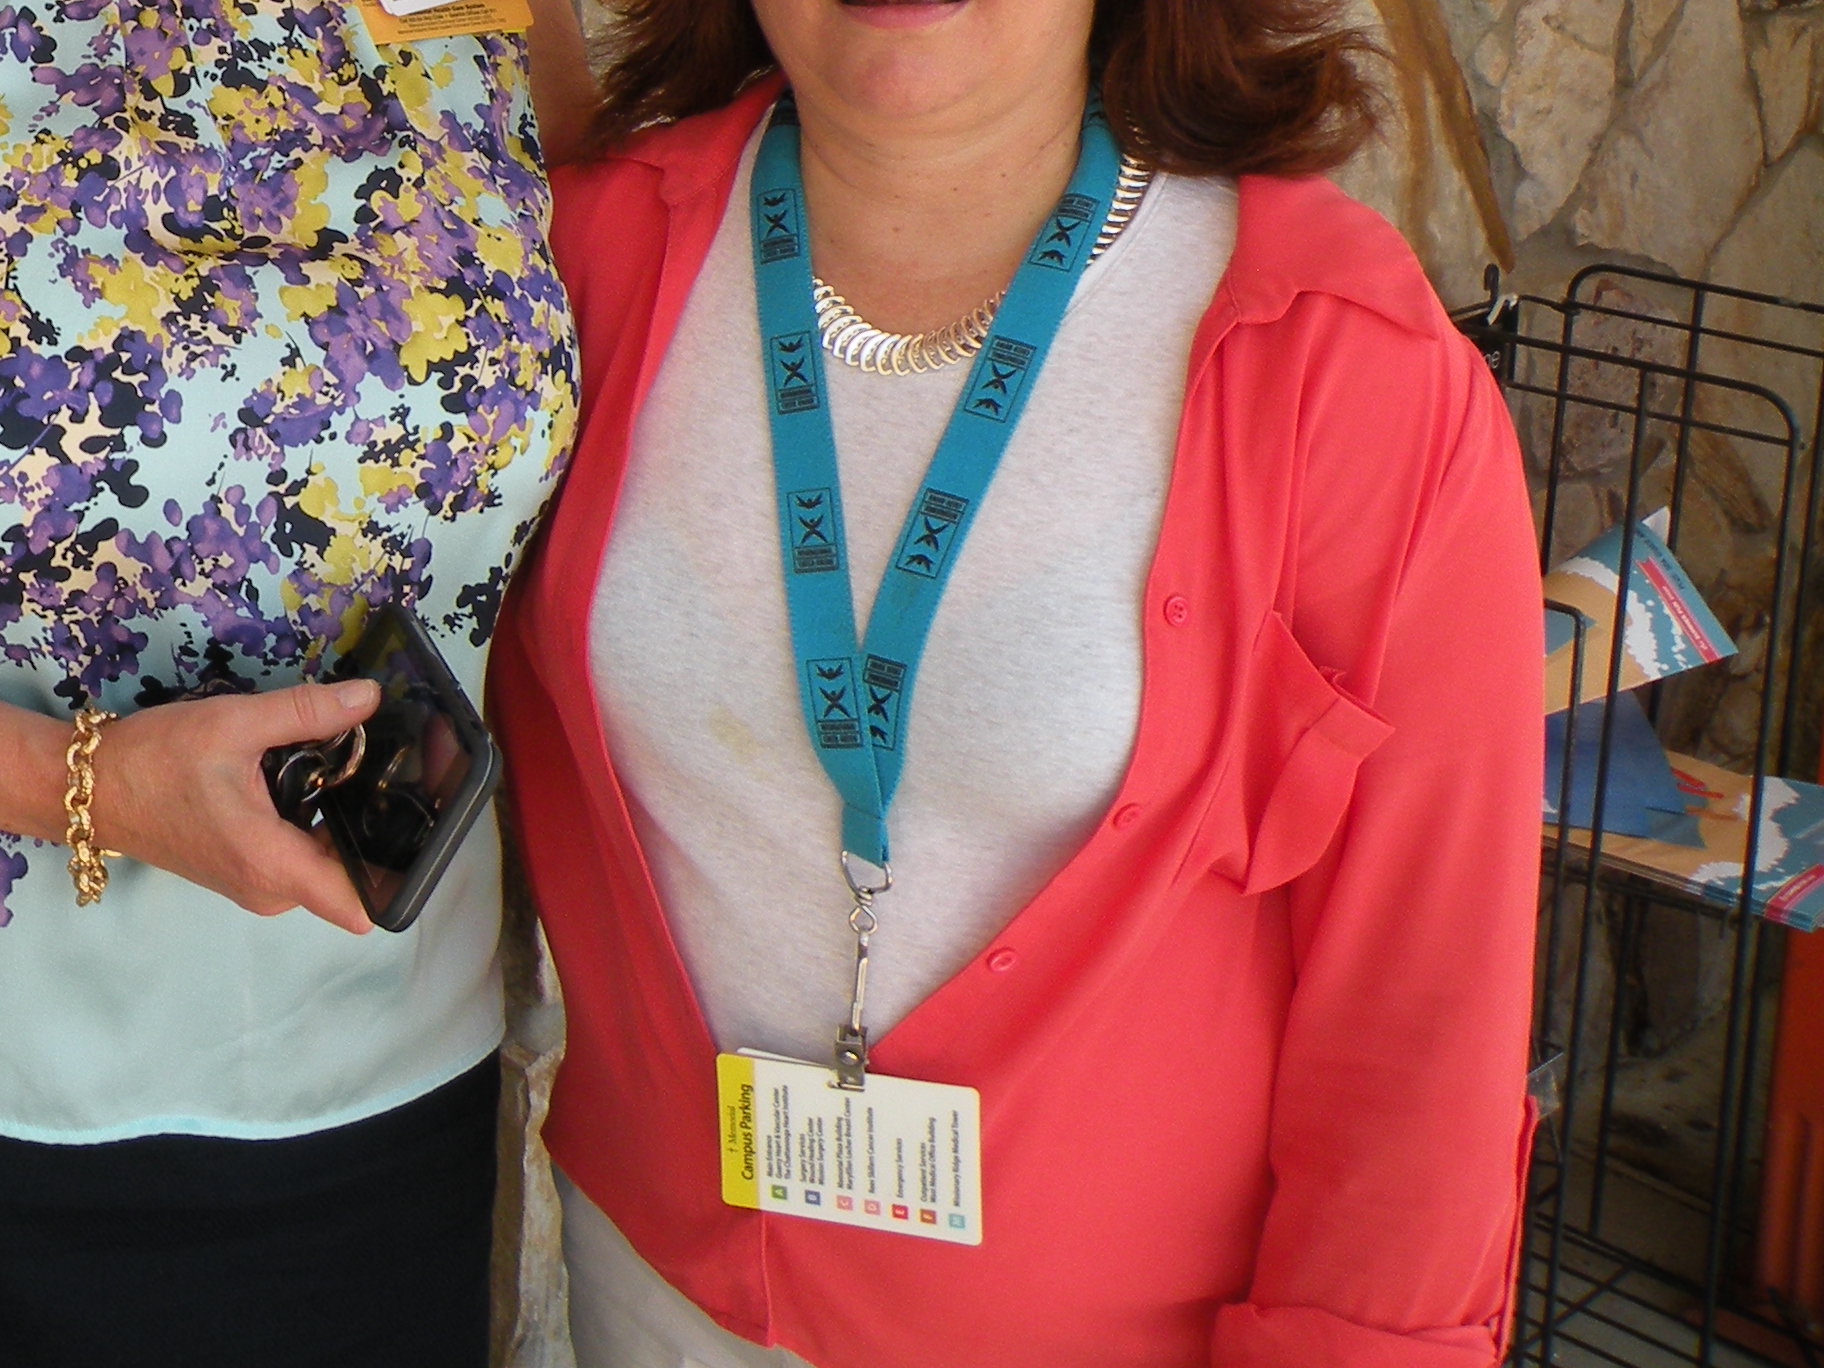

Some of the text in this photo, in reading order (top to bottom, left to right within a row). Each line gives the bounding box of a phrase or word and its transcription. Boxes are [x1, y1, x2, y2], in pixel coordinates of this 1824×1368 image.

[727, 1105, 737, 1144] Memorial
[738, 1083, 756, 1180] Campus Parking
